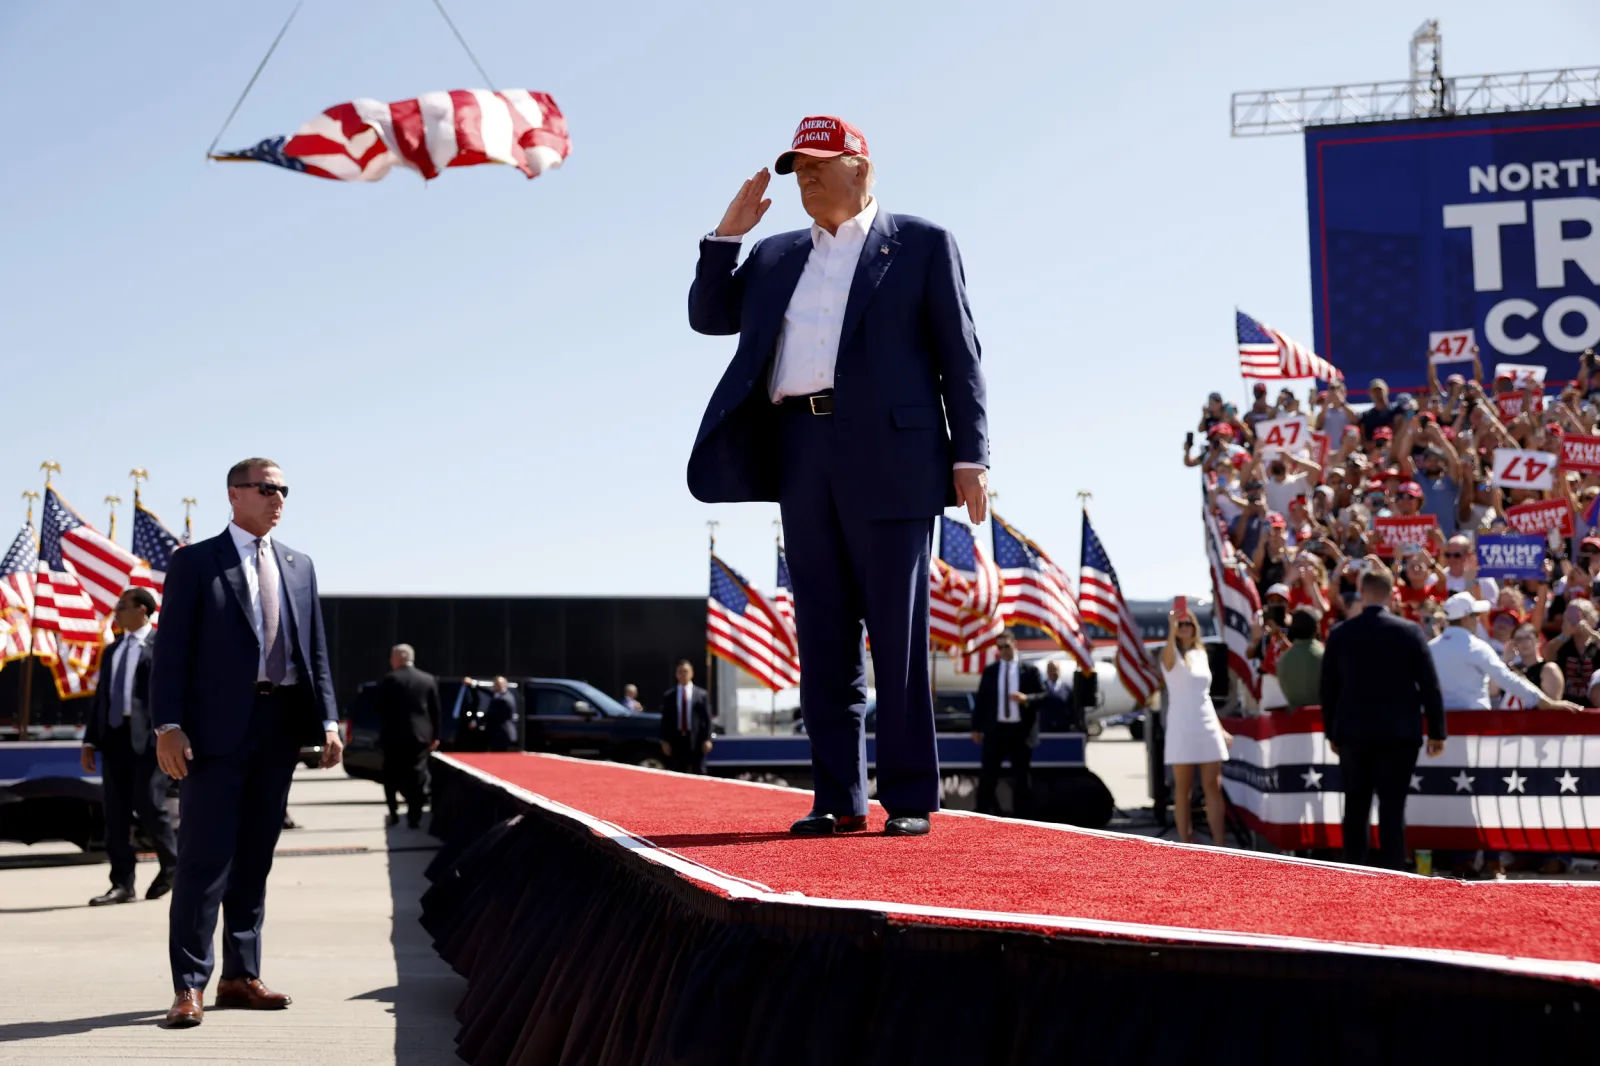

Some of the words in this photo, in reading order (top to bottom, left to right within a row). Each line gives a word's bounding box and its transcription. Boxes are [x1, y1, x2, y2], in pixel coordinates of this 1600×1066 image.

[801, 120, 837, 130] AMERICA
[804, 131, 831, 142] AGAIN
[1442, 196, 1600, 292] TR
[1484, 295, 1600, 356] CO
[1435, 335, 1468, 356] 47
[1264, 421, 1302, 447] 47
[1501, 456, 1548, 482] 47
[1510, 506, 1568, 526] TRUMP
[1479, 543, 1542, 557] TRUMP
[1484, 553, 1536, 565] VANCE
